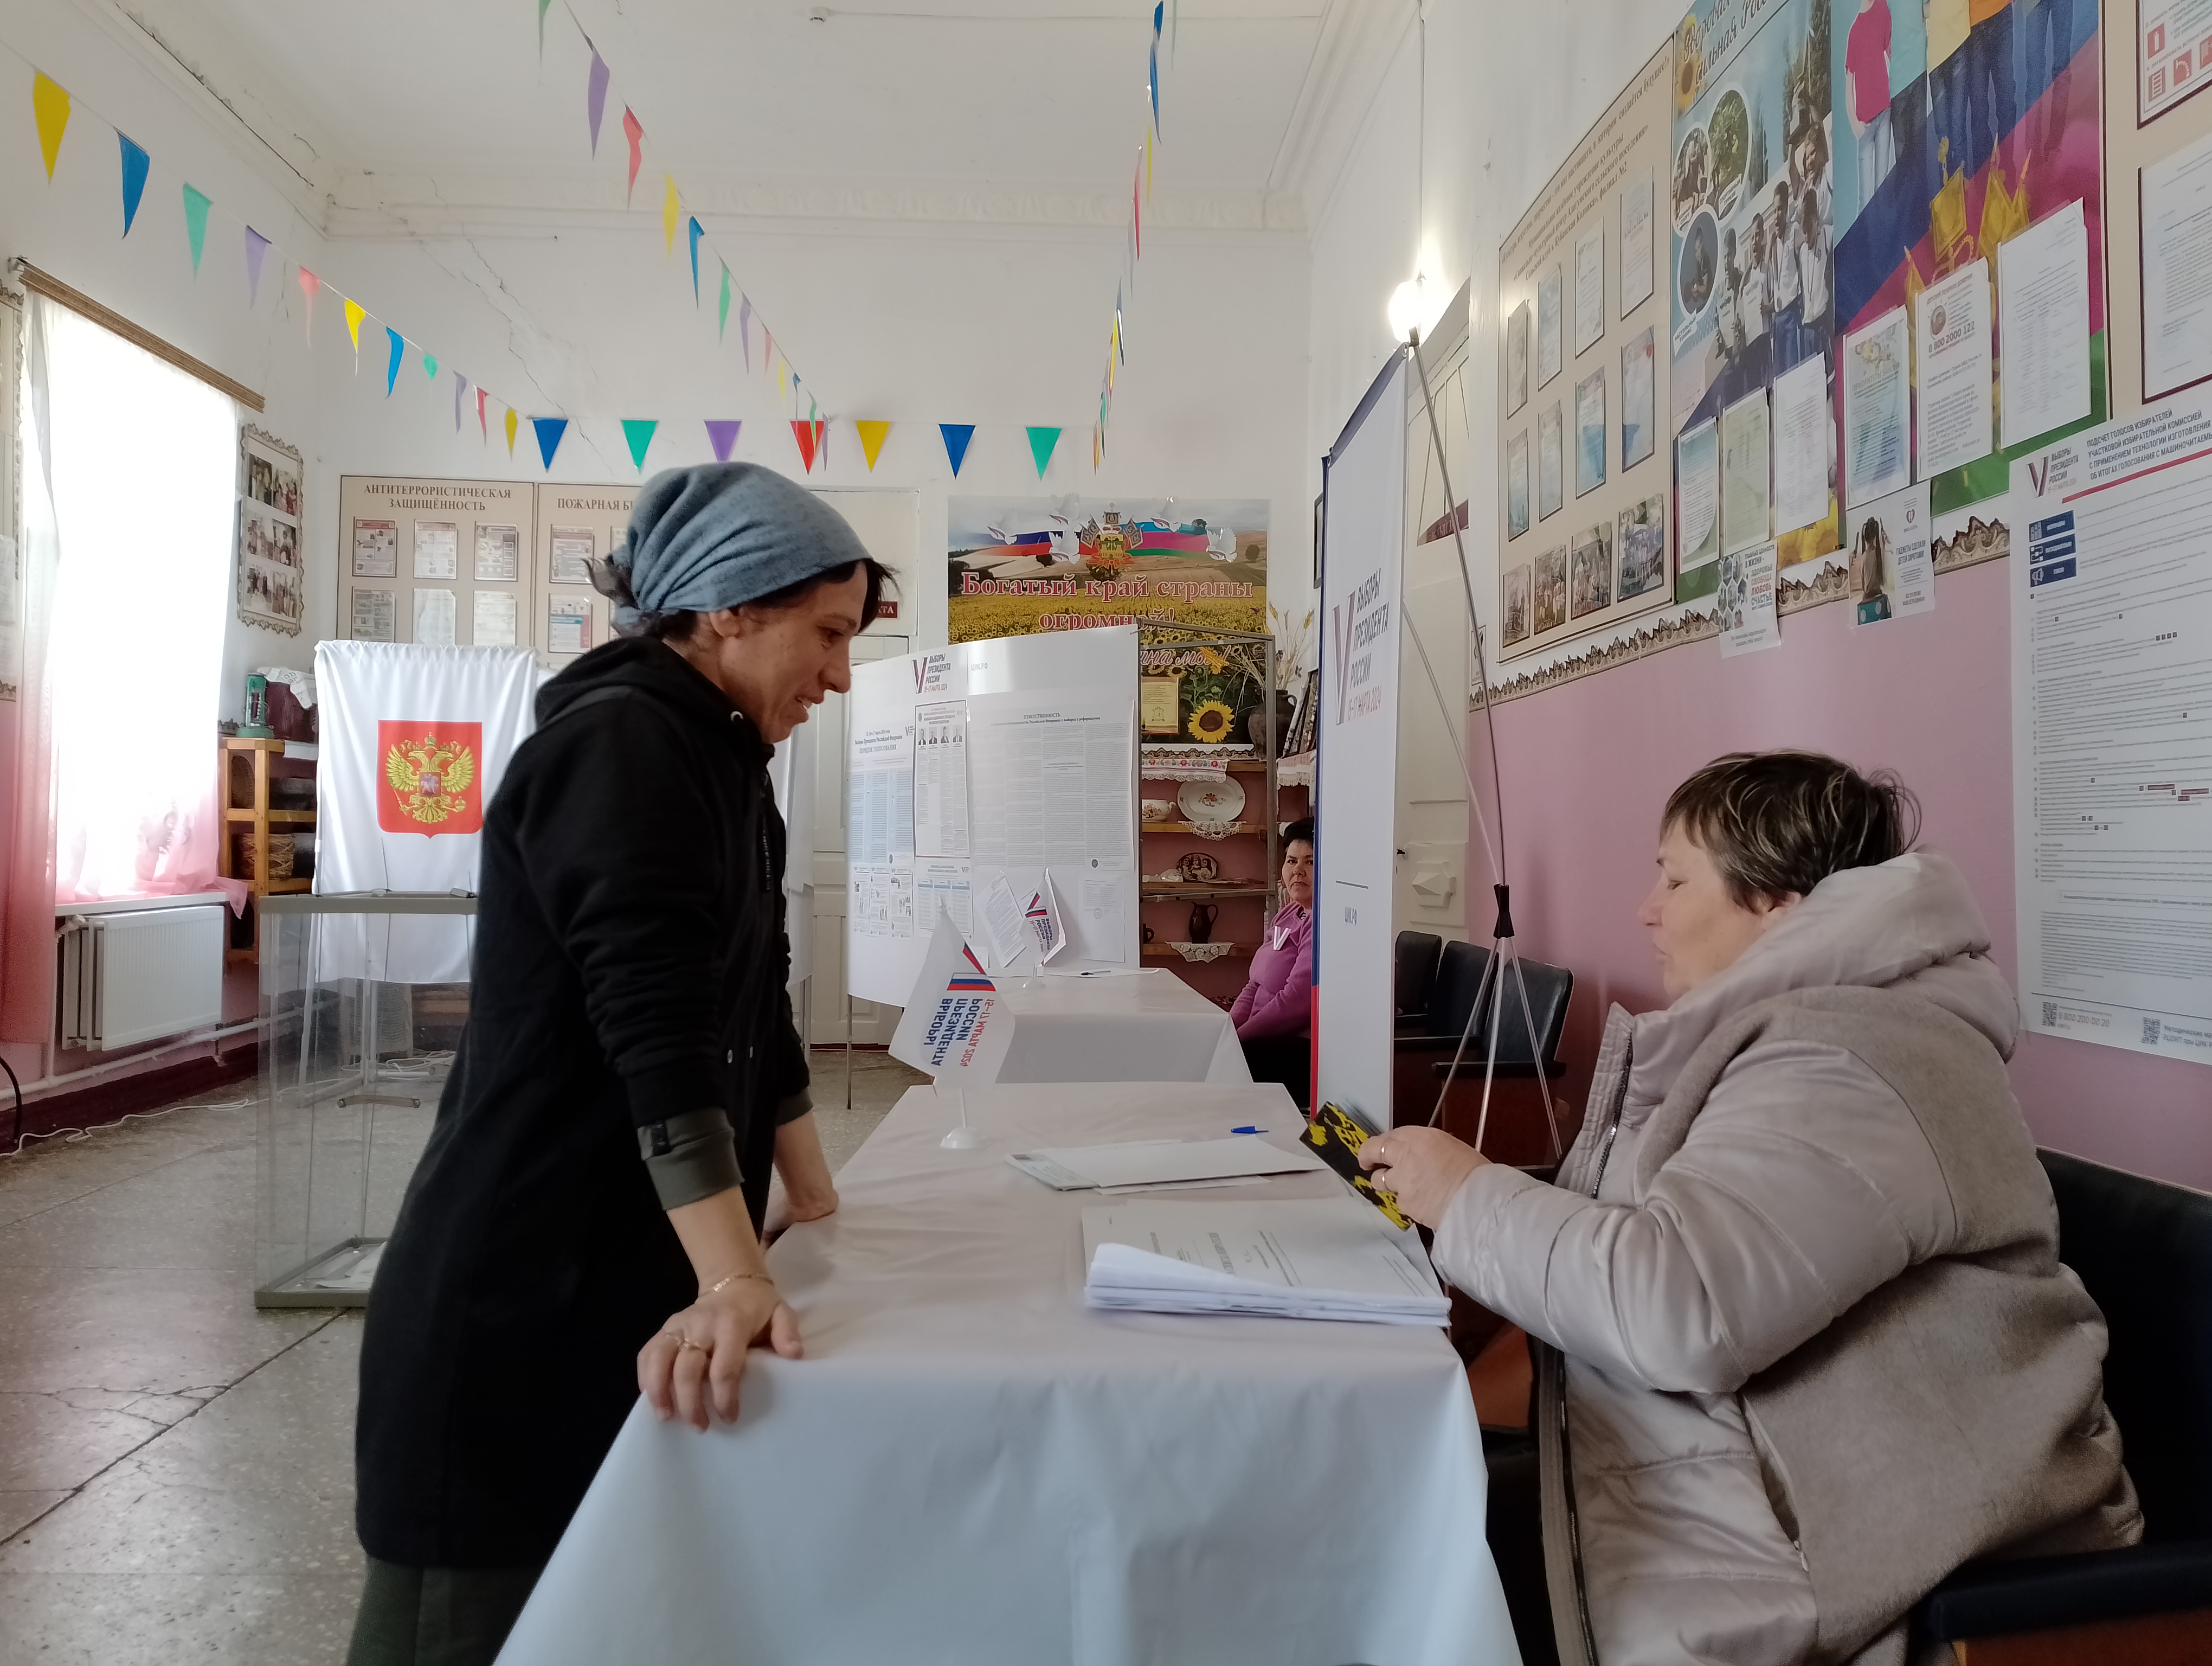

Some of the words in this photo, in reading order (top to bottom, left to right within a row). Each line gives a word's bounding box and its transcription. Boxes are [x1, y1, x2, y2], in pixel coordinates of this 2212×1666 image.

[1696, 15, 1738, 86] сильная
[1600, 133, 1623, 165] культуры
[1946, 328, 1962, 343] 2000
[1963, 321, 1975, 335] 122
[2087, 433, 2110, 448] ПОДСЧЕТ
[2111, 424, 2134, 439] ГОЛОСОВ
[2135, 408, 2173, 430] ИЗБИРАТЕЛЕЙ
[2088, 438, 2122, 458] УЧАСТКОВОЙ
[2123, 422, 2167, 446] ИЗБИРАТЕЛЬНОЙ
[2168, 409, 2202, 430] КОМИССИЕЙ
[2093, 450, 2131, 467] ПРИМЕНЕНИЕМ
[2132, 436, 2167, 453] ТЕХНОЛОГИИ
[2168, 420, 2211, 443] ИЗГОТОВЛЕНИЯ
[2090, 471, 2098, 480] ОБ
[2098, 466, 2118, 478] ИТОГАХ
[2118, 451, 2155, 471] ГОЛОСОВАНИЯ
[364, 484, 511, 498] АНТИТЕРРОРИСТИЧЕСКАЯ
[389, 497, 486, 511] ЗАЩИЩЁННОСТЬ
[557, 498, 620, 510] ПОЖАРНАЯ
[1751, 564, 1773, 576] ЗДОРОВЬЕ
[1751, 573, 1772, 586] СВОБОДА
[961, 572, 1077, 597] Богатый
[1084, 575, 1149, 603] край
[1156, 580, 1253, 603] страны
[1356, 567, 1381, 613] ВЫБОРЫ
[1751, 582, 1772, 596] ЛЮБОВЬ
[1751, 592, 1772, 606] СЧАСТЬЕ
[1353, 601, 1389, 652] ПРЕЗИДЕНТА
[927, 662, 951, 674] ПРЕЗИДЕНТА
[929, 653, 946, 664] ВЫБОРЫ
[1140, 650, 1174, 666] ина
[925, 675, 941, 684] РОССИИ
[971, 663, 988, 671] ЦИК.РФ
[1350, 652, 1372, 690] РОССИИ
[1371, 684, 1381, 713] 2024
[1035, 919, 1046, 940] РОССИИ
